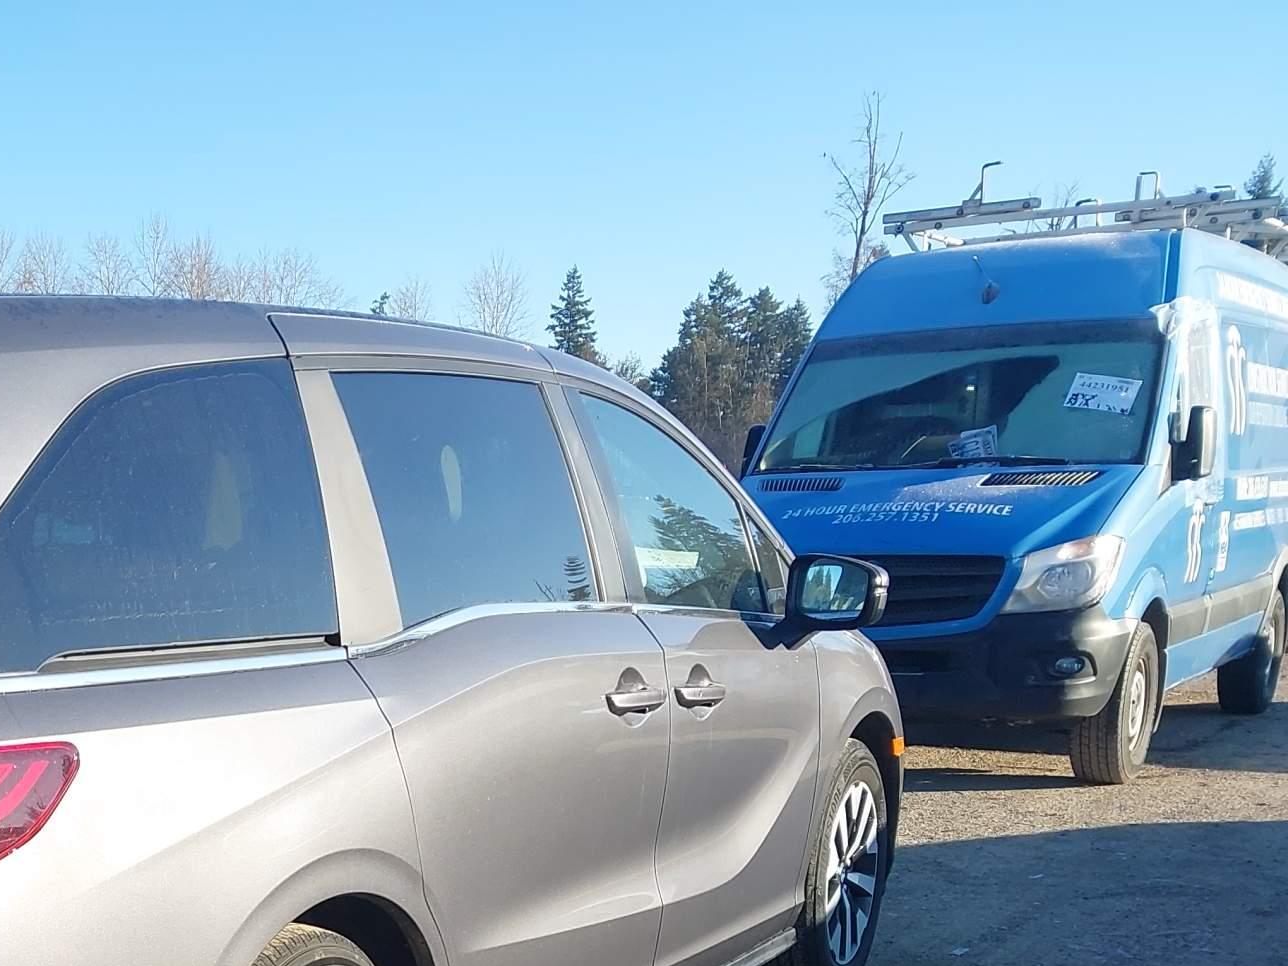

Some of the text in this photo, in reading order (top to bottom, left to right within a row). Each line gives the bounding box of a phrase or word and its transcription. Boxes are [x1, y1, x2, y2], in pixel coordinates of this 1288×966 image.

[781, 500, 1014, 520] 24 HOUR EMERGENCY SERVICE
[831, 511, 940, 525] 206.257.1351
